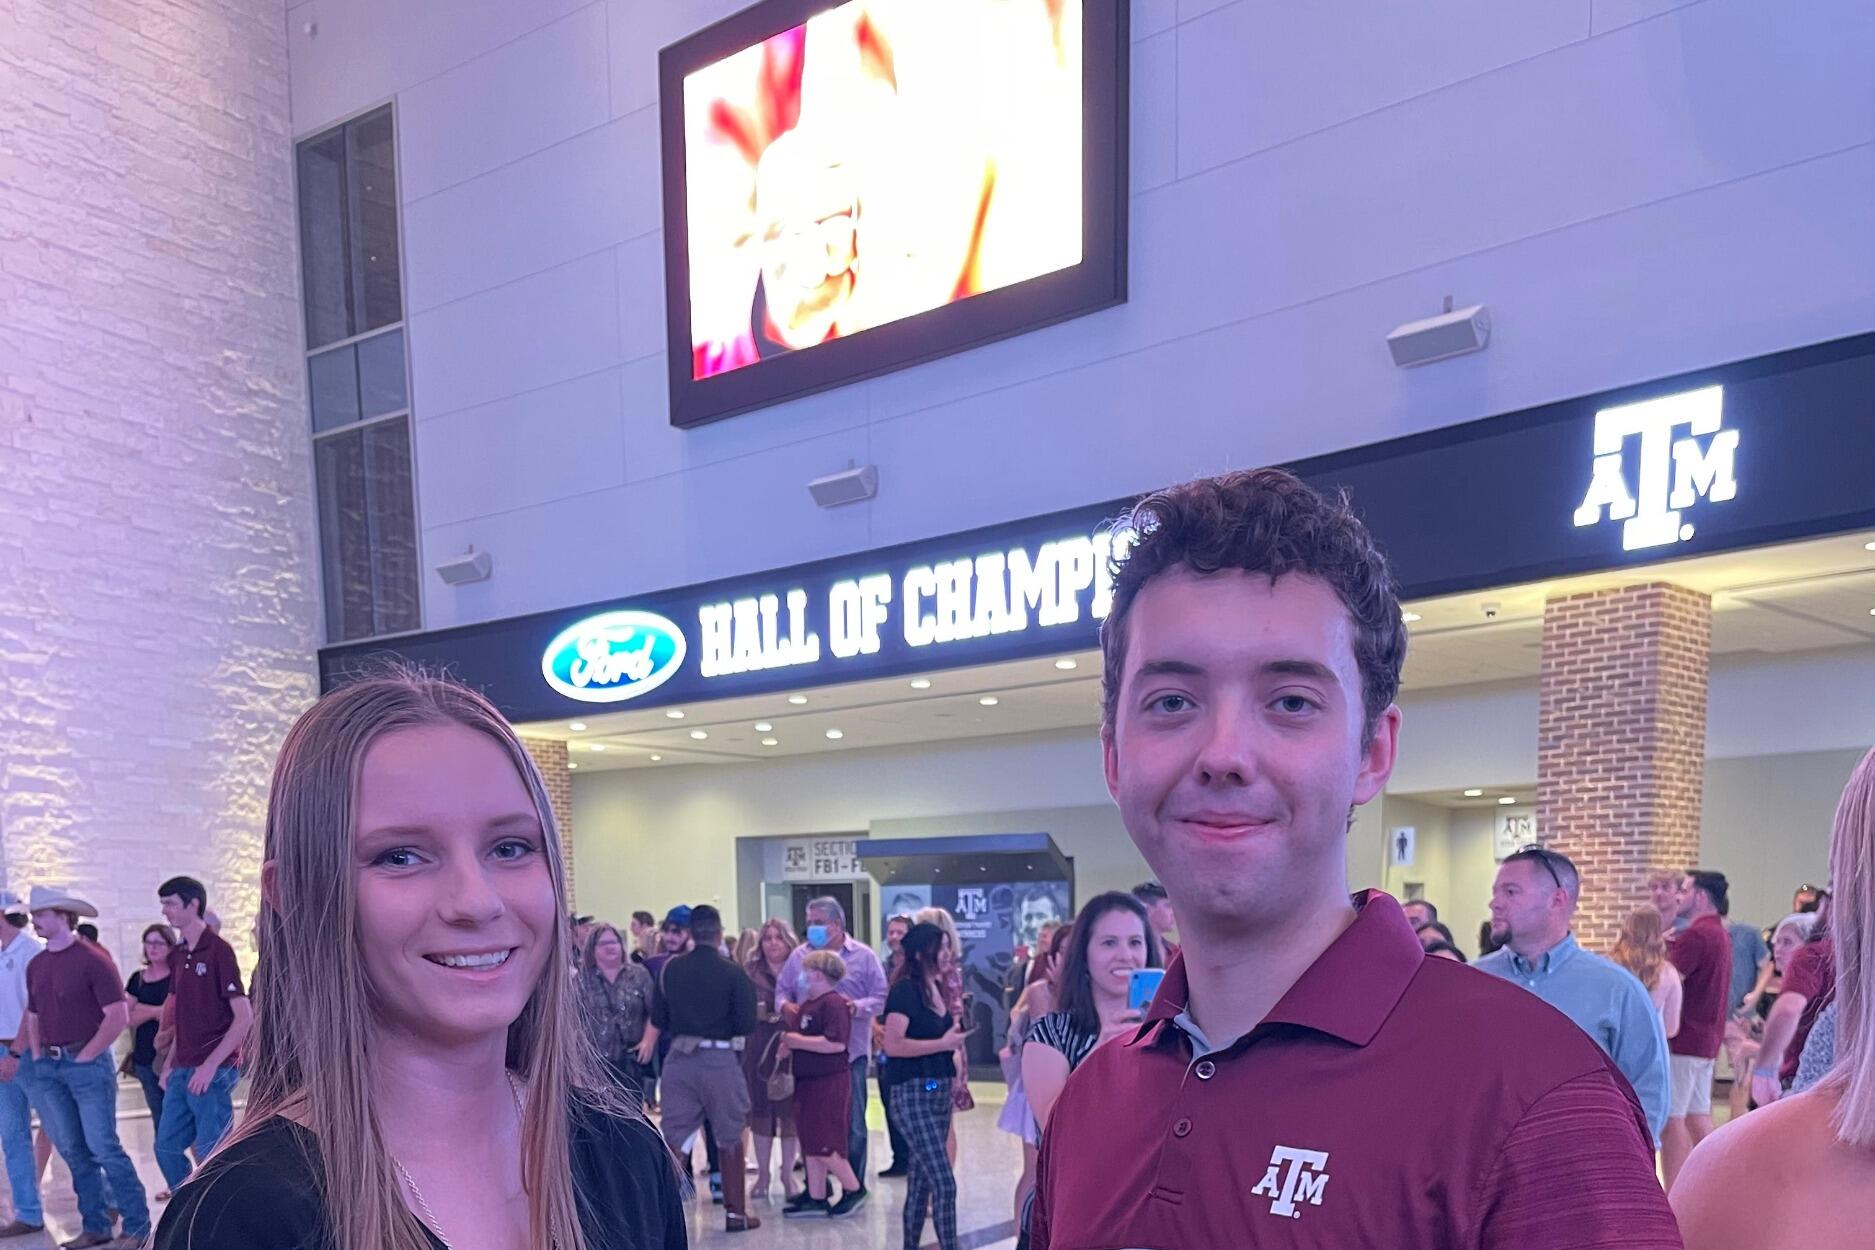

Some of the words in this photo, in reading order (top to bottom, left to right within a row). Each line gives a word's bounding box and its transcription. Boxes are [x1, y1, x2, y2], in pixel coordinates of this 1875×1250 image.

[569, 624, 655, 688] Ford
[699, 589, 820, 678] HALL
[829, 573, 892, 659] OF
